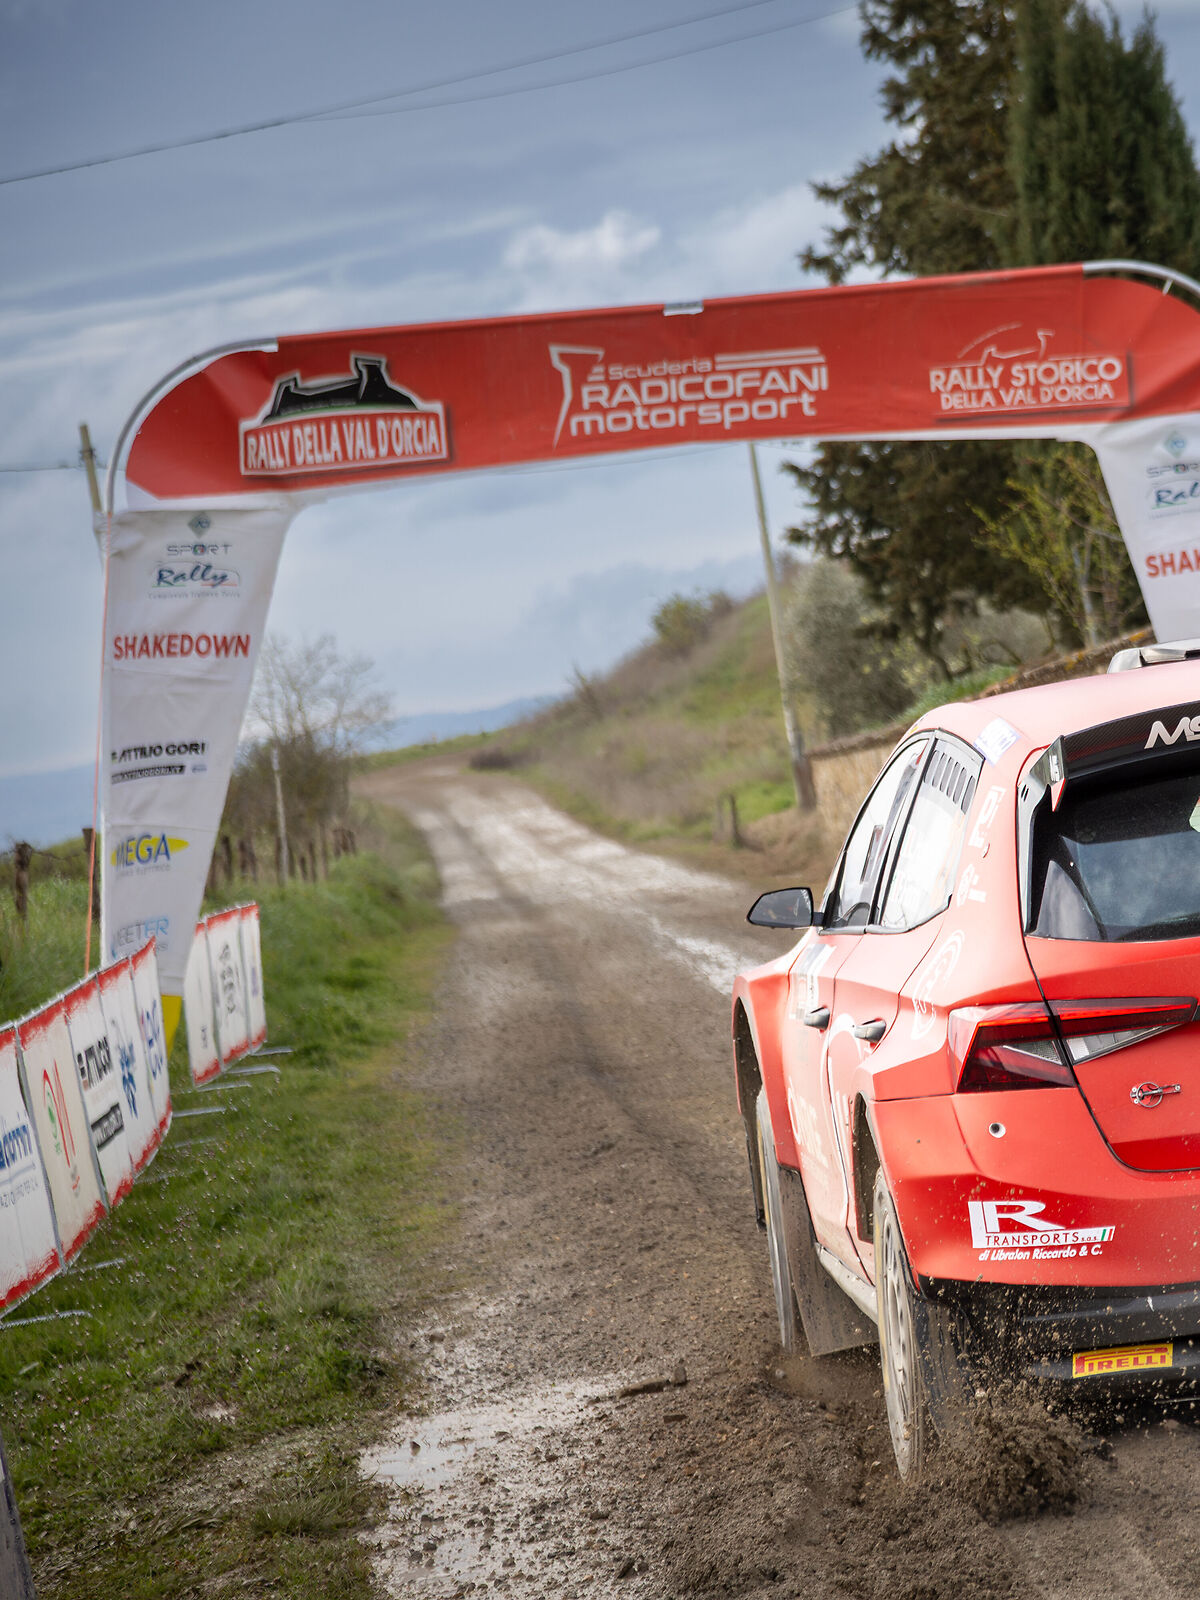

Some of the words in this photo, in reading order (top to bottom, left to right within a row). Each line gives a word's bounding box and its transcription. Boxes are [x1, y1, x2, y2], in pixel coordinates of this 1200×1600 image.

[608, 357, 714, 381] Scuderia
[929, 365, 1004, 394] RALLY
[1010, 355, 1122, 387] STORICO
[581, 365, 830, 411] RADICOFANI
[940, 389, 995, 411] DELLA
[999, 387, 1036, 407] VAL
[1039, 381, 1115, 404] D'ORCIA
[570, 391, 817, 437] motorsport
[247, 430, 291, 469] RALLY
[292, 422, 343, 466] DELLA
[343, 420, 376, 461] VAL
[376, 417, 440, 458] D'ORCIA
[167, 543, 232, 556] SPORT
[156, 564, 230, 588] Rally
[113, 632, 250, 661] SHAKEDOWN
[165, 742, 206, 757] GORI
[115, 833, 171, 869] MEGA
[978, 1249, 989, 1262] di
[1032, 1245, 1077, 1260] Riccardo
[1079, 1245, 1089, 1257] &
[1090, 1244, 1103, 1256] C.
[985, 1231, 1080, 1247] TRANSPORTS
[1075, 1347, 1168, 1374] PIRELLI
